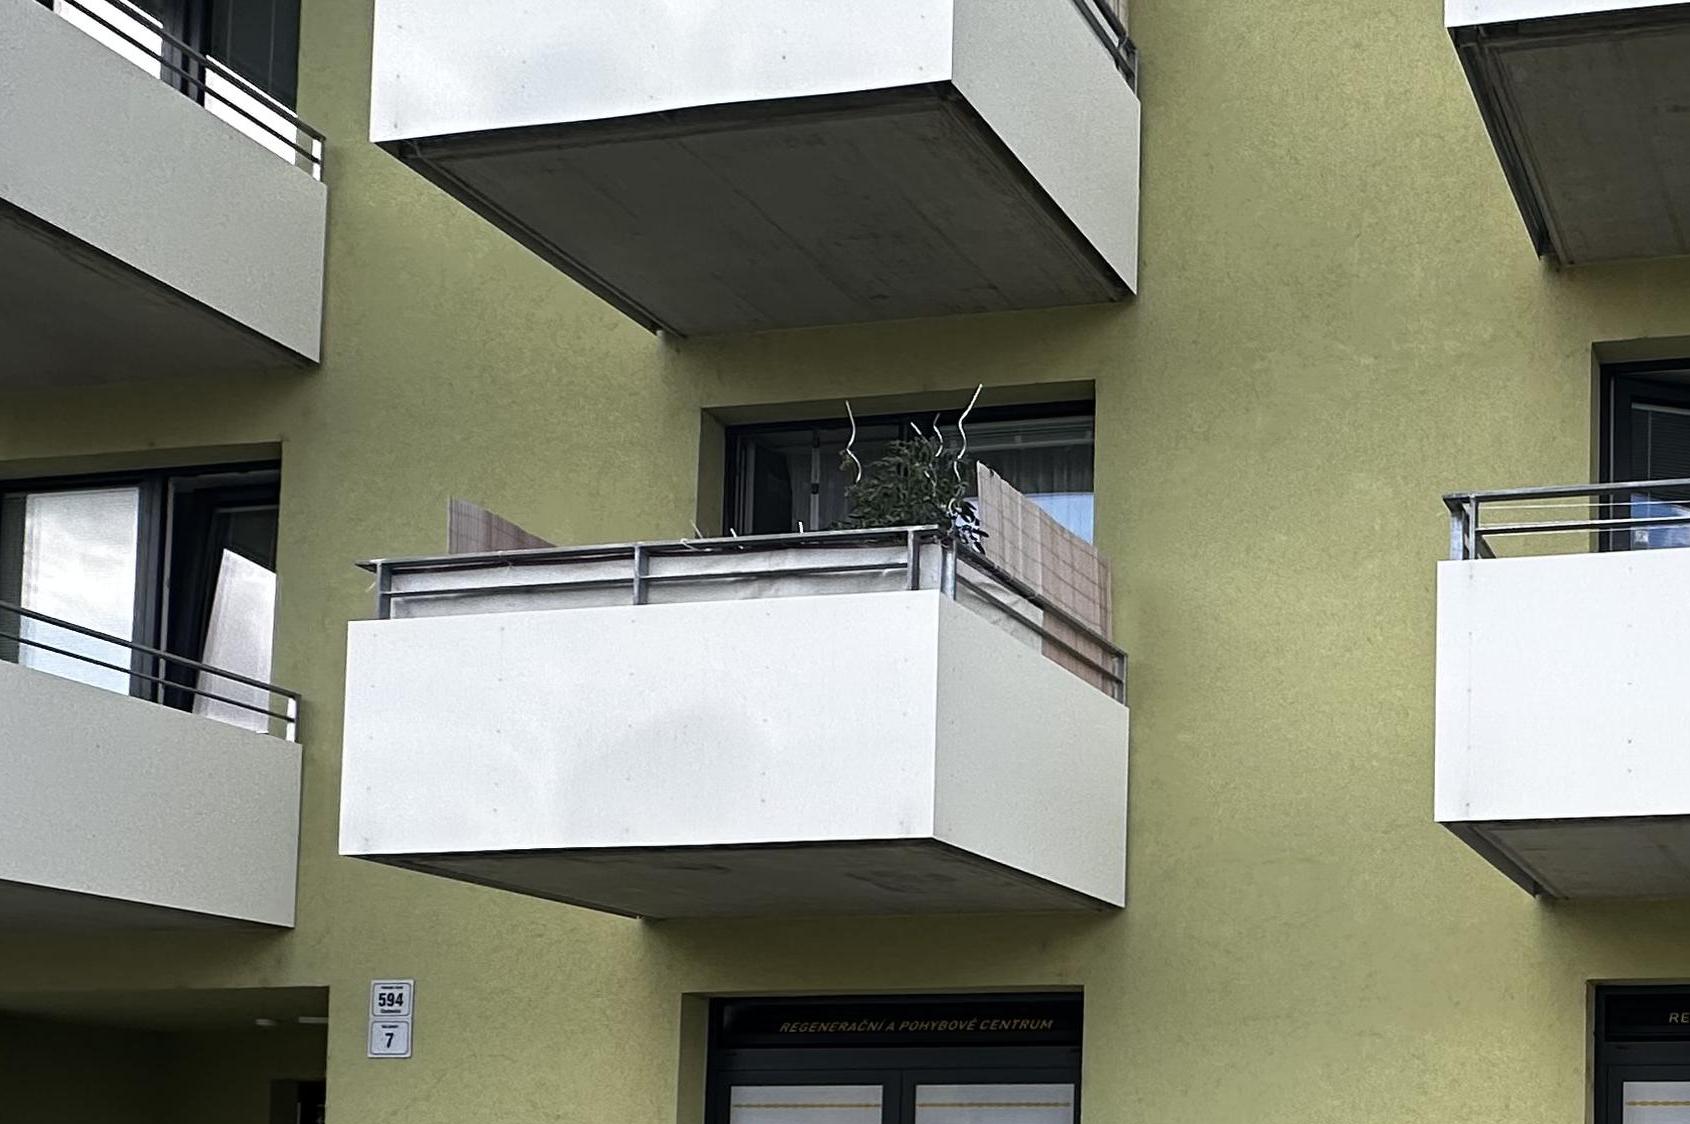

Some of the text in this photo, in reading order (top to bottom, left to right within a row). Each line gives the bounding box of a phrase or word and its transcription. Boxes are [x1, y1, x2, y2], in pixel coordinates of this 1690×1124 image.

[378, 992, 404, 1007] 594
[779, 1017, 1054, 1033] REGENERAČNÍ A POHYBOVÉ CENTRUM
[385, 1032, 394, 1048] 7
